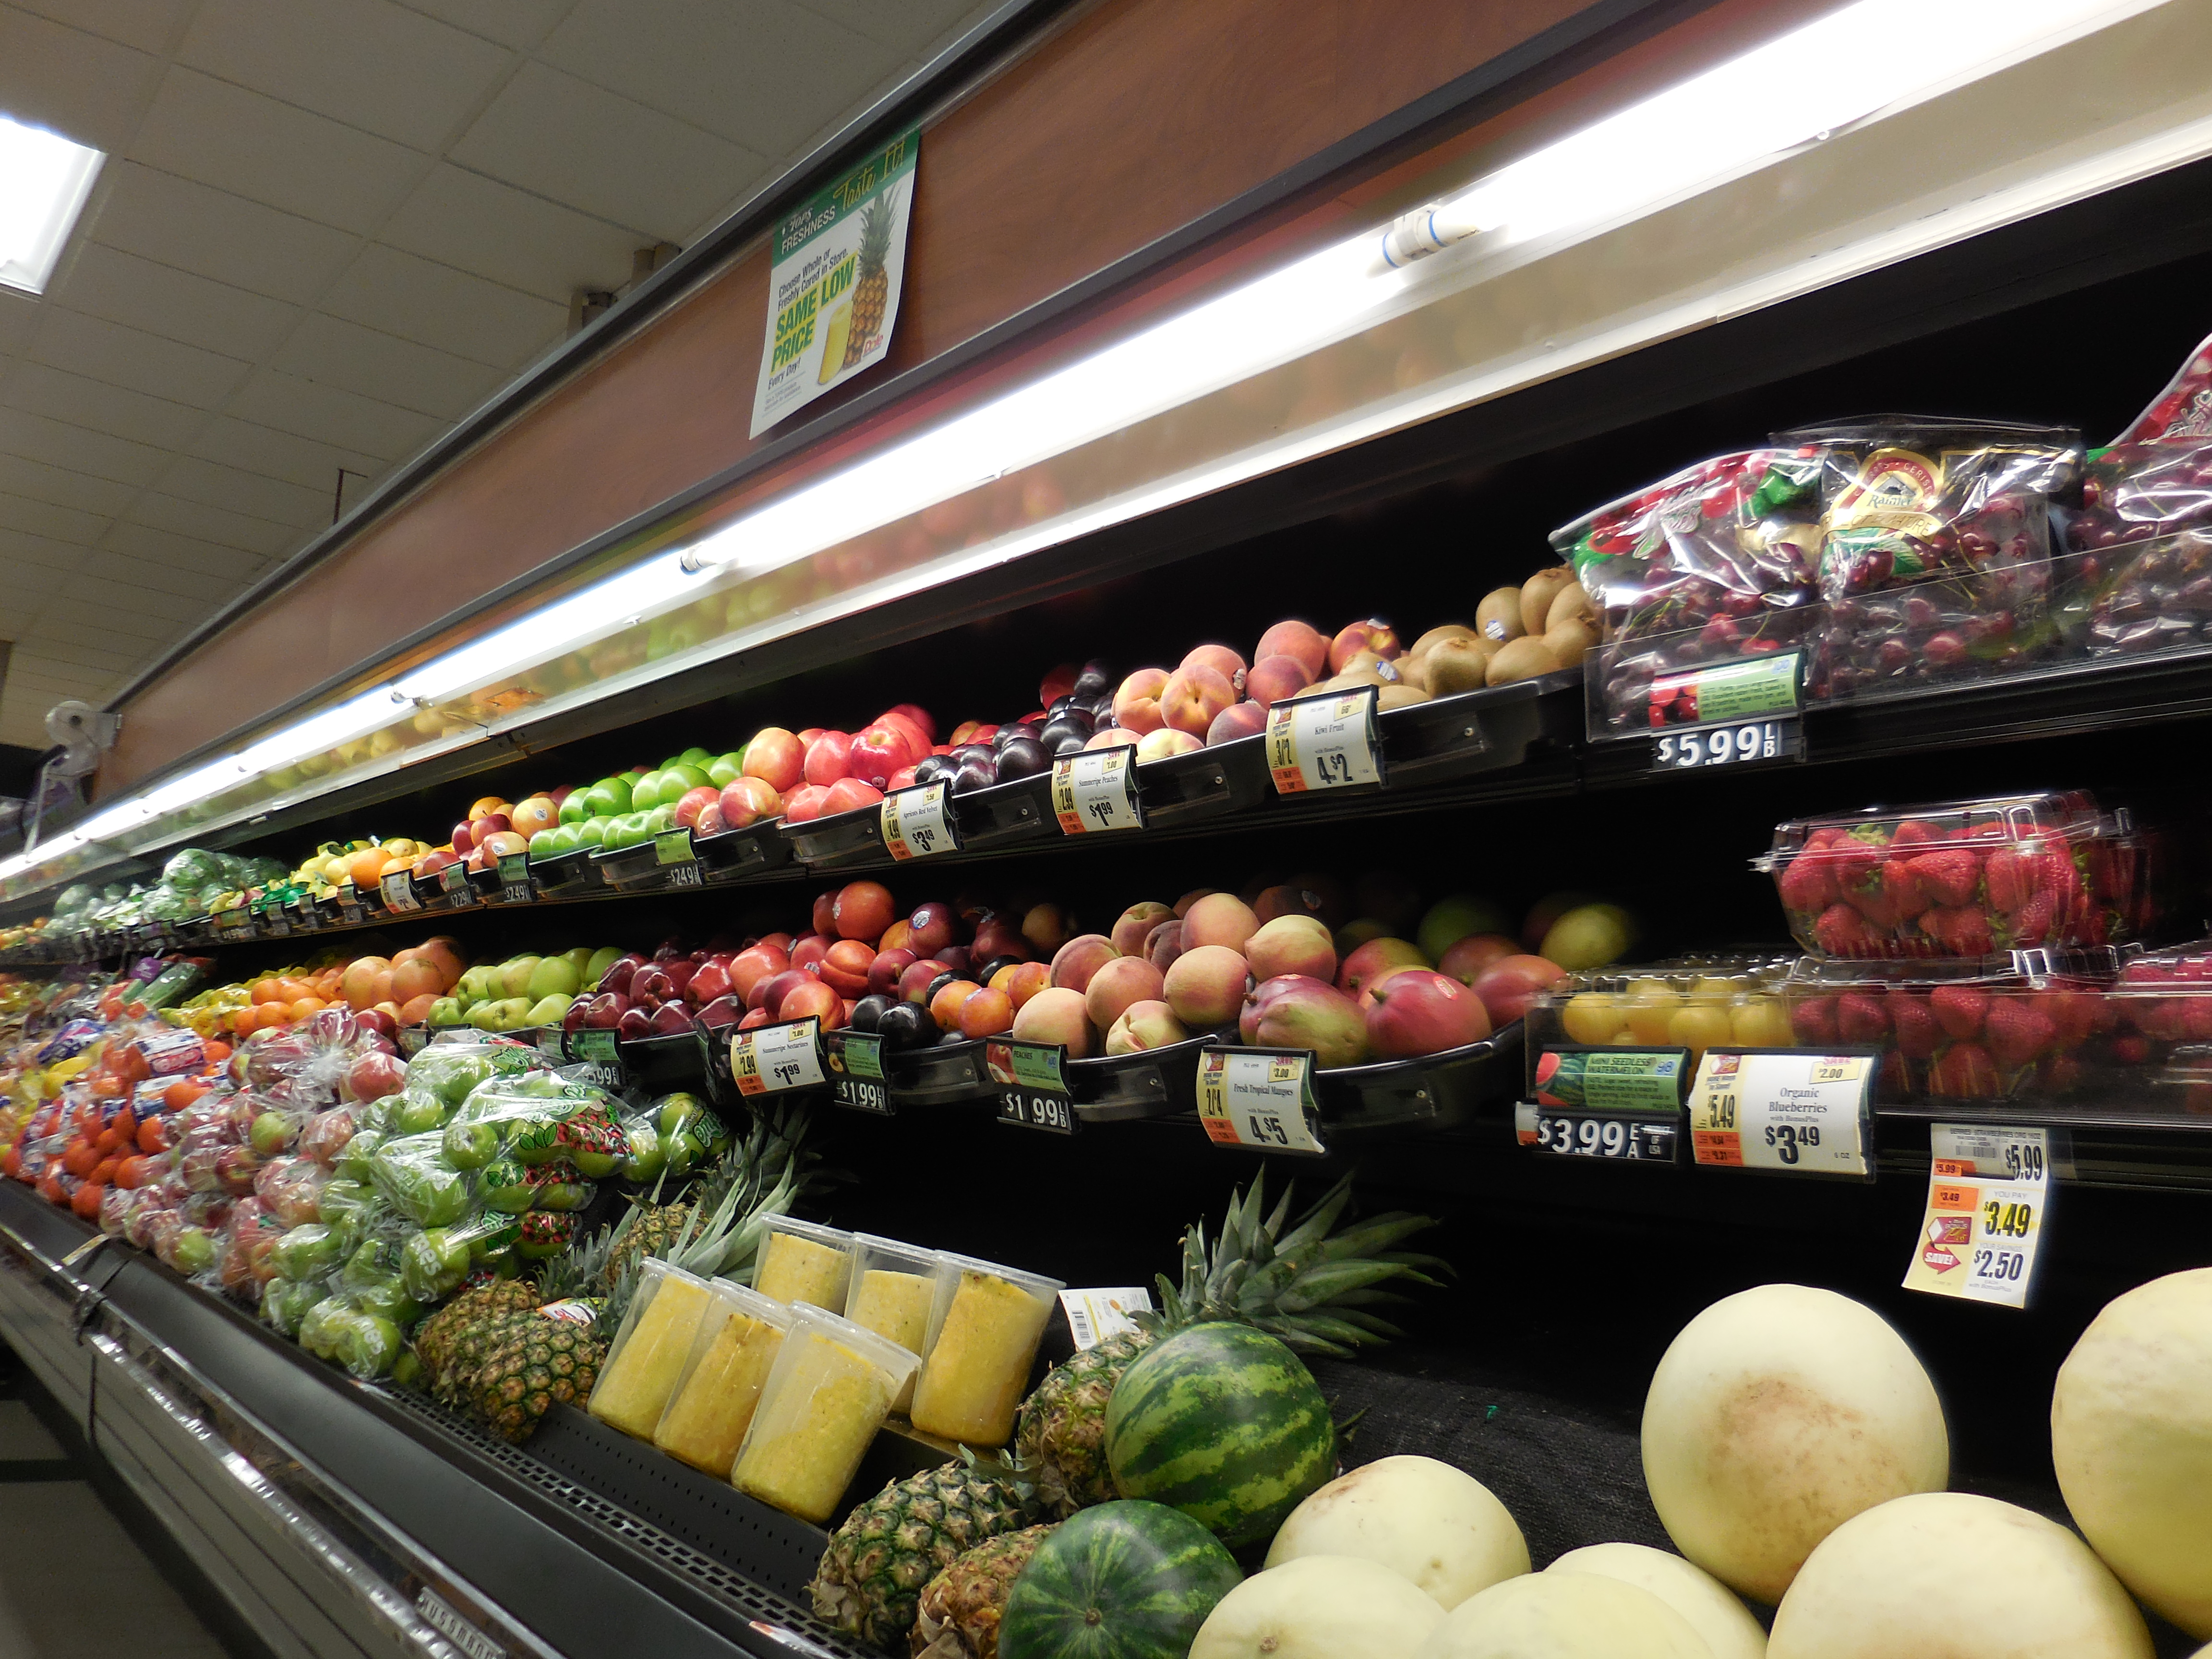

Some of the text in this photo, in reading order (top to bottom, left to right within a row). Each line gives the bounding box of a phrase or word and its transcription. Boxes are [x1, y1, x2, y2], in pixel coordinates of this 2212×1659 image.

[833, 166, 876, 212] Taste
[781, 205, 835, 254] FRESHNESS
[778, 249, 848, 312] Freshly Cored in Store.
[779, 248, 831, 298] Choose Whole or
[776, 256, 855, 341] SAME LOW
[771, 319, 815, 373] PRICE
[768, 357, 801, 390] Every Day!
[1315, 723, 1344, 735] Kiwi Fruit
[1657, 725, 1761, 767] $5.99
[1102, 775, 1118, 783] Peaches
[926, 805, 938, 814] Velvet
[787, 1041, 808, 1049] Nectarines
[740, 1055, 756, 1075] $2.99
[1588, 1065, 1645, 1074] WATERMELON
[1611, 1058, 1651, 1066] SEEDLESS
[1818, 1069, 1843, 1079] $2.00
[842, 1081, 877, 1107] $1.99
[1234, 1083, 1293, 1098] Fresh Tropical Mangoes
[1780, 1087, 1819, 1100] Organic
[1006, 1092, 1058, 1126] $1.99
[1707, 1094, 1735, 1128] $5.49
[1768, 1101, 1827, 1113] Blueberries
[1537, 1118, 1624, 1156] $3.99
[1936, 1163, 1956, 1174] $5.99
[2005, 1144, 2043, 1181] $5.99
[1984, 1201, 2032, 1238] $3.49
[1924, 1251, 1954, 1265] SAVE!
[1973, 1250, 2024, 1281] $2.50
[1981, 1284, 2012, 1292] BonusPlus
